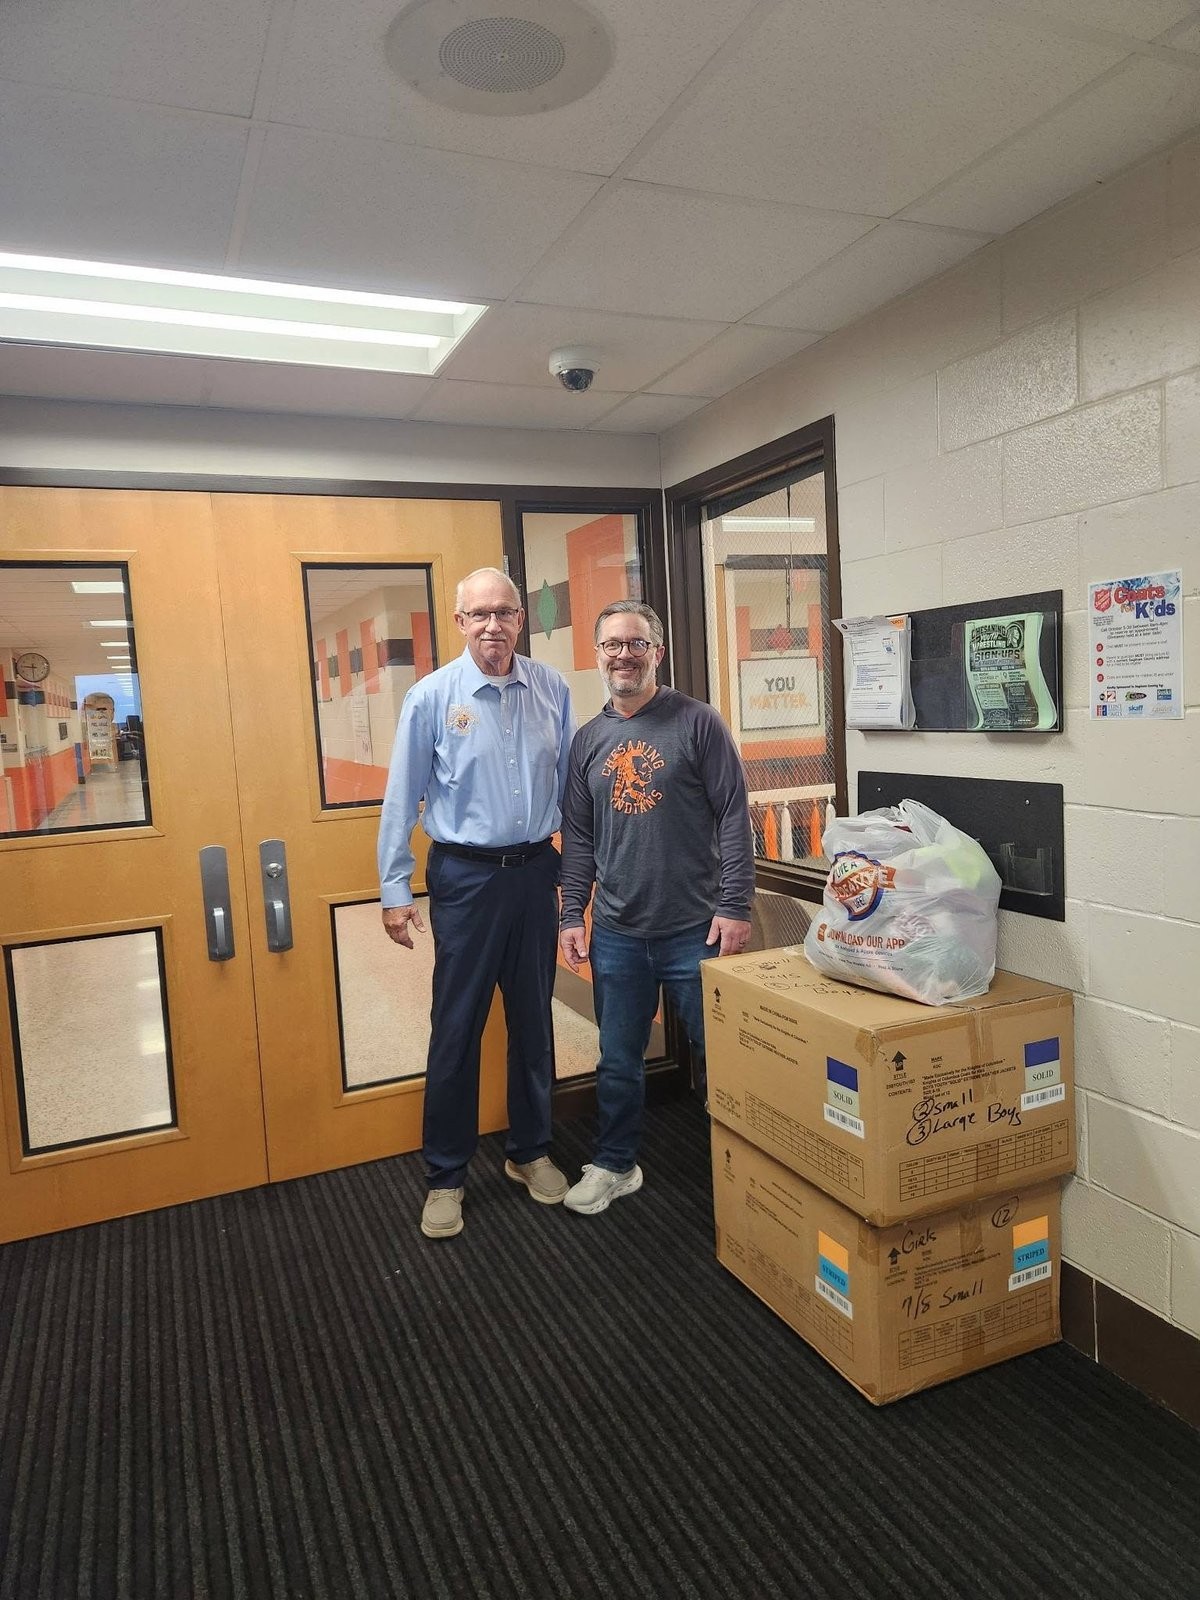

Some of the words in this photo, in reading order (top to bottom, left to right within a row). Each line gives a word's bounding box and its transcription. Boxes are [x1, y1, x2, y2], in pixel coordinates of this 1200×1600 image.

[1114, 585, 1166, 604] Coats
[1135, 599, 1176, 621] Kids
[972, 640, 1006, 651] WRESTLING
[974, 650, 1020, 662] SIGN-UPS
[765, 676, 795, 692] YOU
[601, 740, 665, 777] CHESANING
[610, 789, 663, 815] INDIANS
[866, 935, 883, 948] OUR
[886, 938, 905, 950] APP
[1032, 1069, 1054, 1082] SOLID
[833, 1090, 853, 1106] SOLID
[935, 1088, 973, 1116] Small
[933, 1111, 976, 1132] Large
[988, 1102, 1022, 1126] Boys
[1017, 1248, 1044, 1264] STRIPED
[822, 1263, 846, 1288] STRIPED
[939, 1278, 984, 1308] Small
